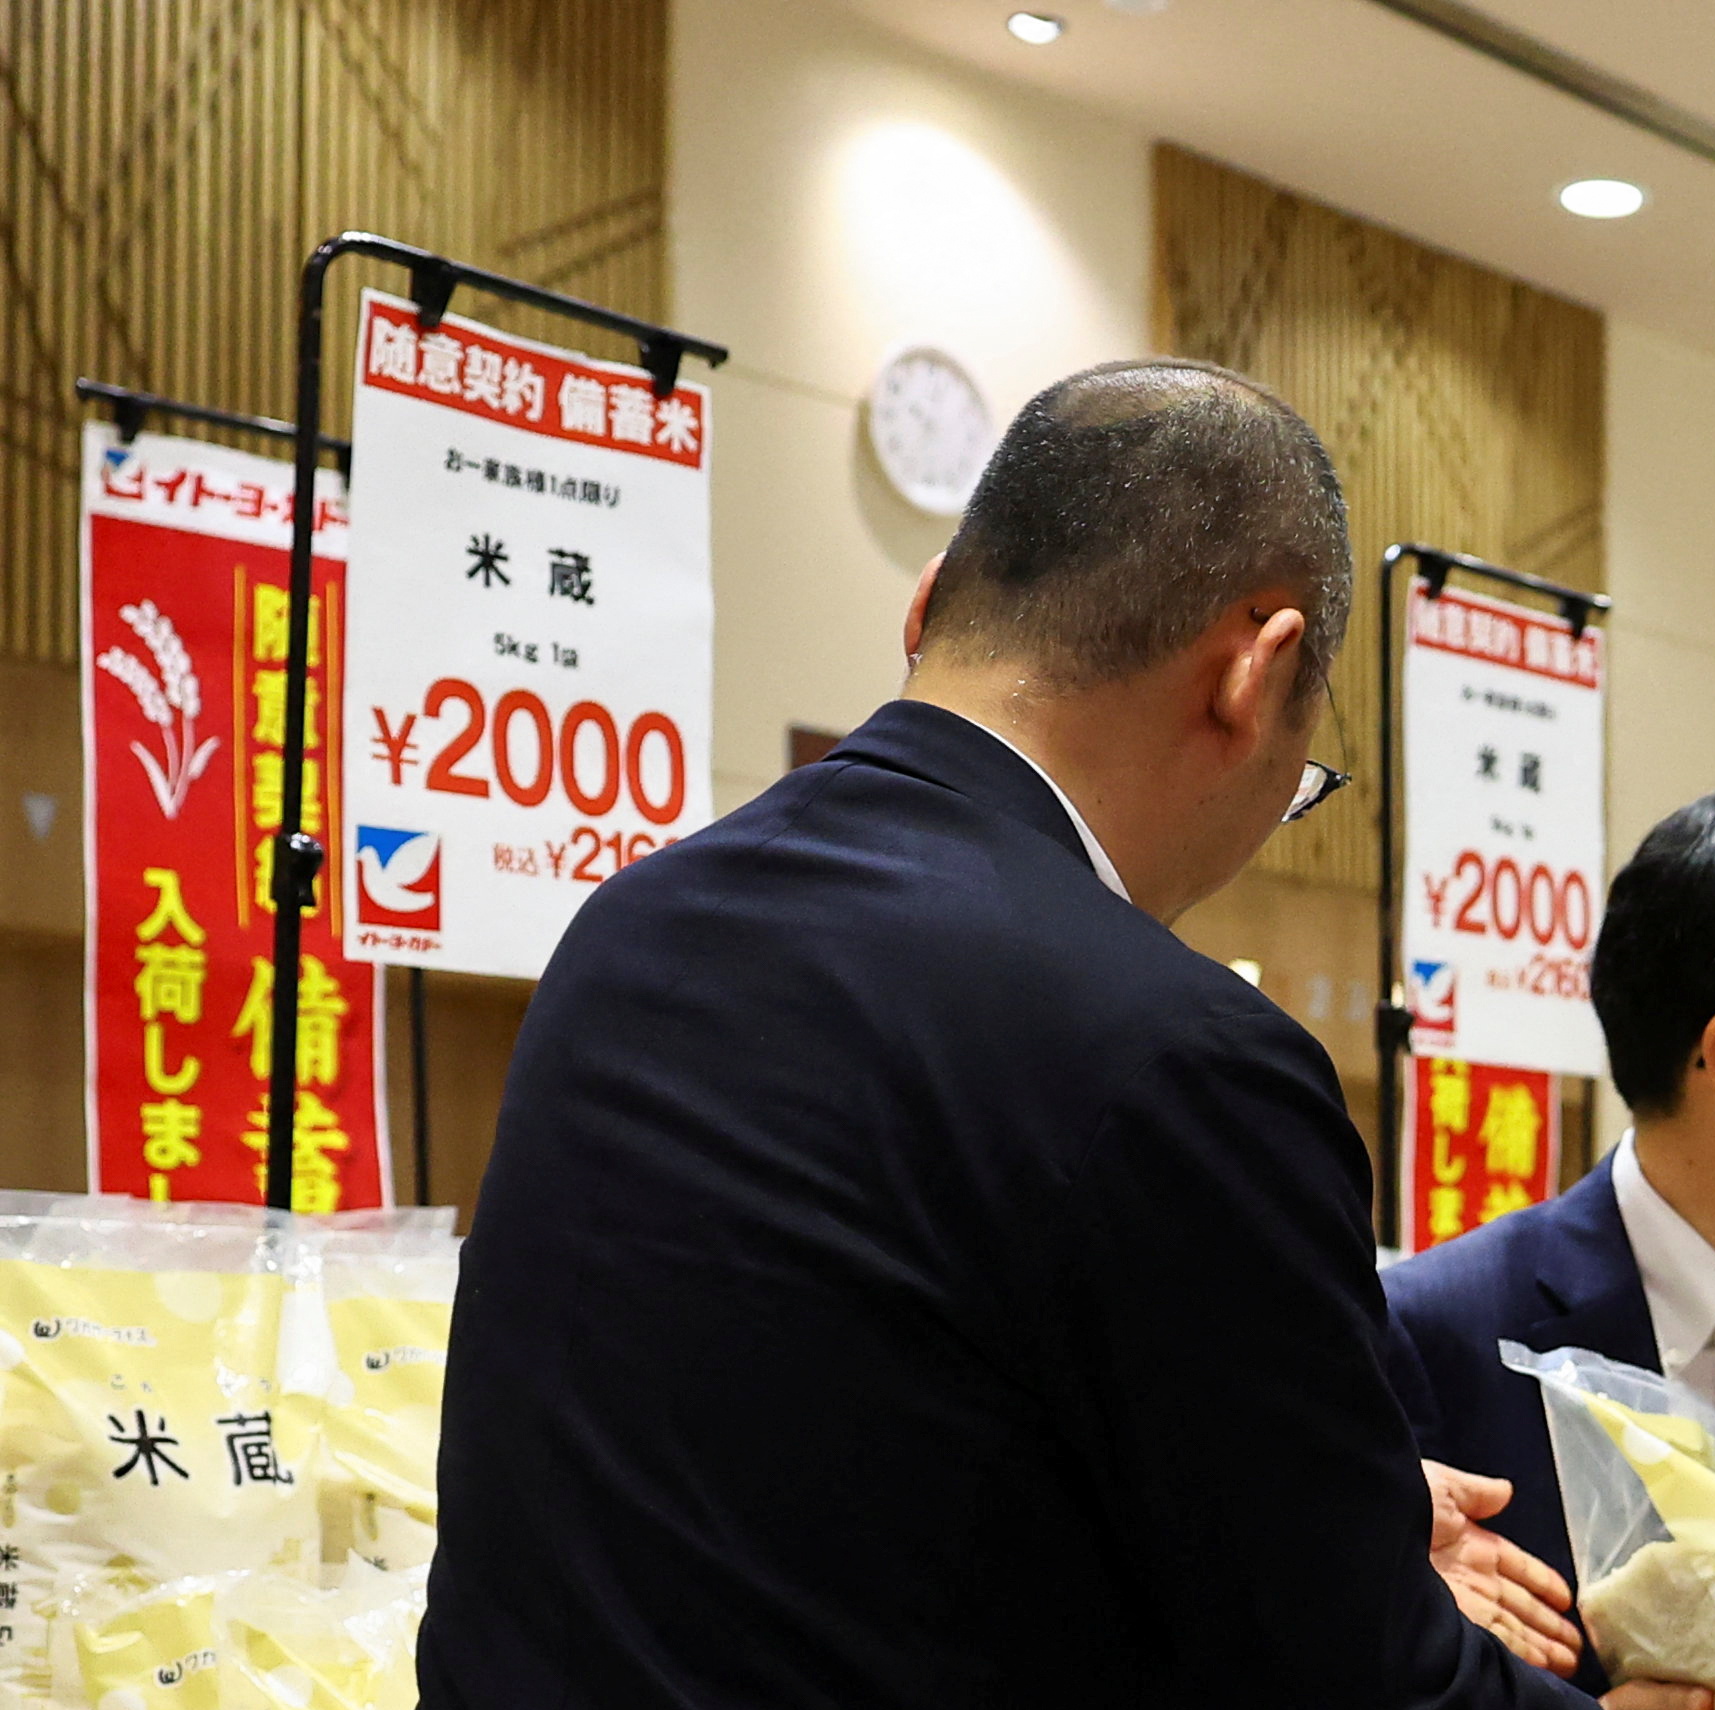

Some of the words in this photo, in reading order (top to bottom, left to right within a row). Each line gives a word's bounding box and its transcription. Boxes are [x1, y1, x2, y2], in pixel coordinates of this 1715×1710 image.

[369, 316, 546, 423] 随意契約
[558, 372, 700, 454] 備蓄米
[465, 531, 597, 606] 米蔵
[493, 631, 540, 665] 5kg
[371, 677, 686, 825] ¥2000
[1423, 847, 1591, 951] ¥2000
[108, 1409, 294, 1487] 米蔵
